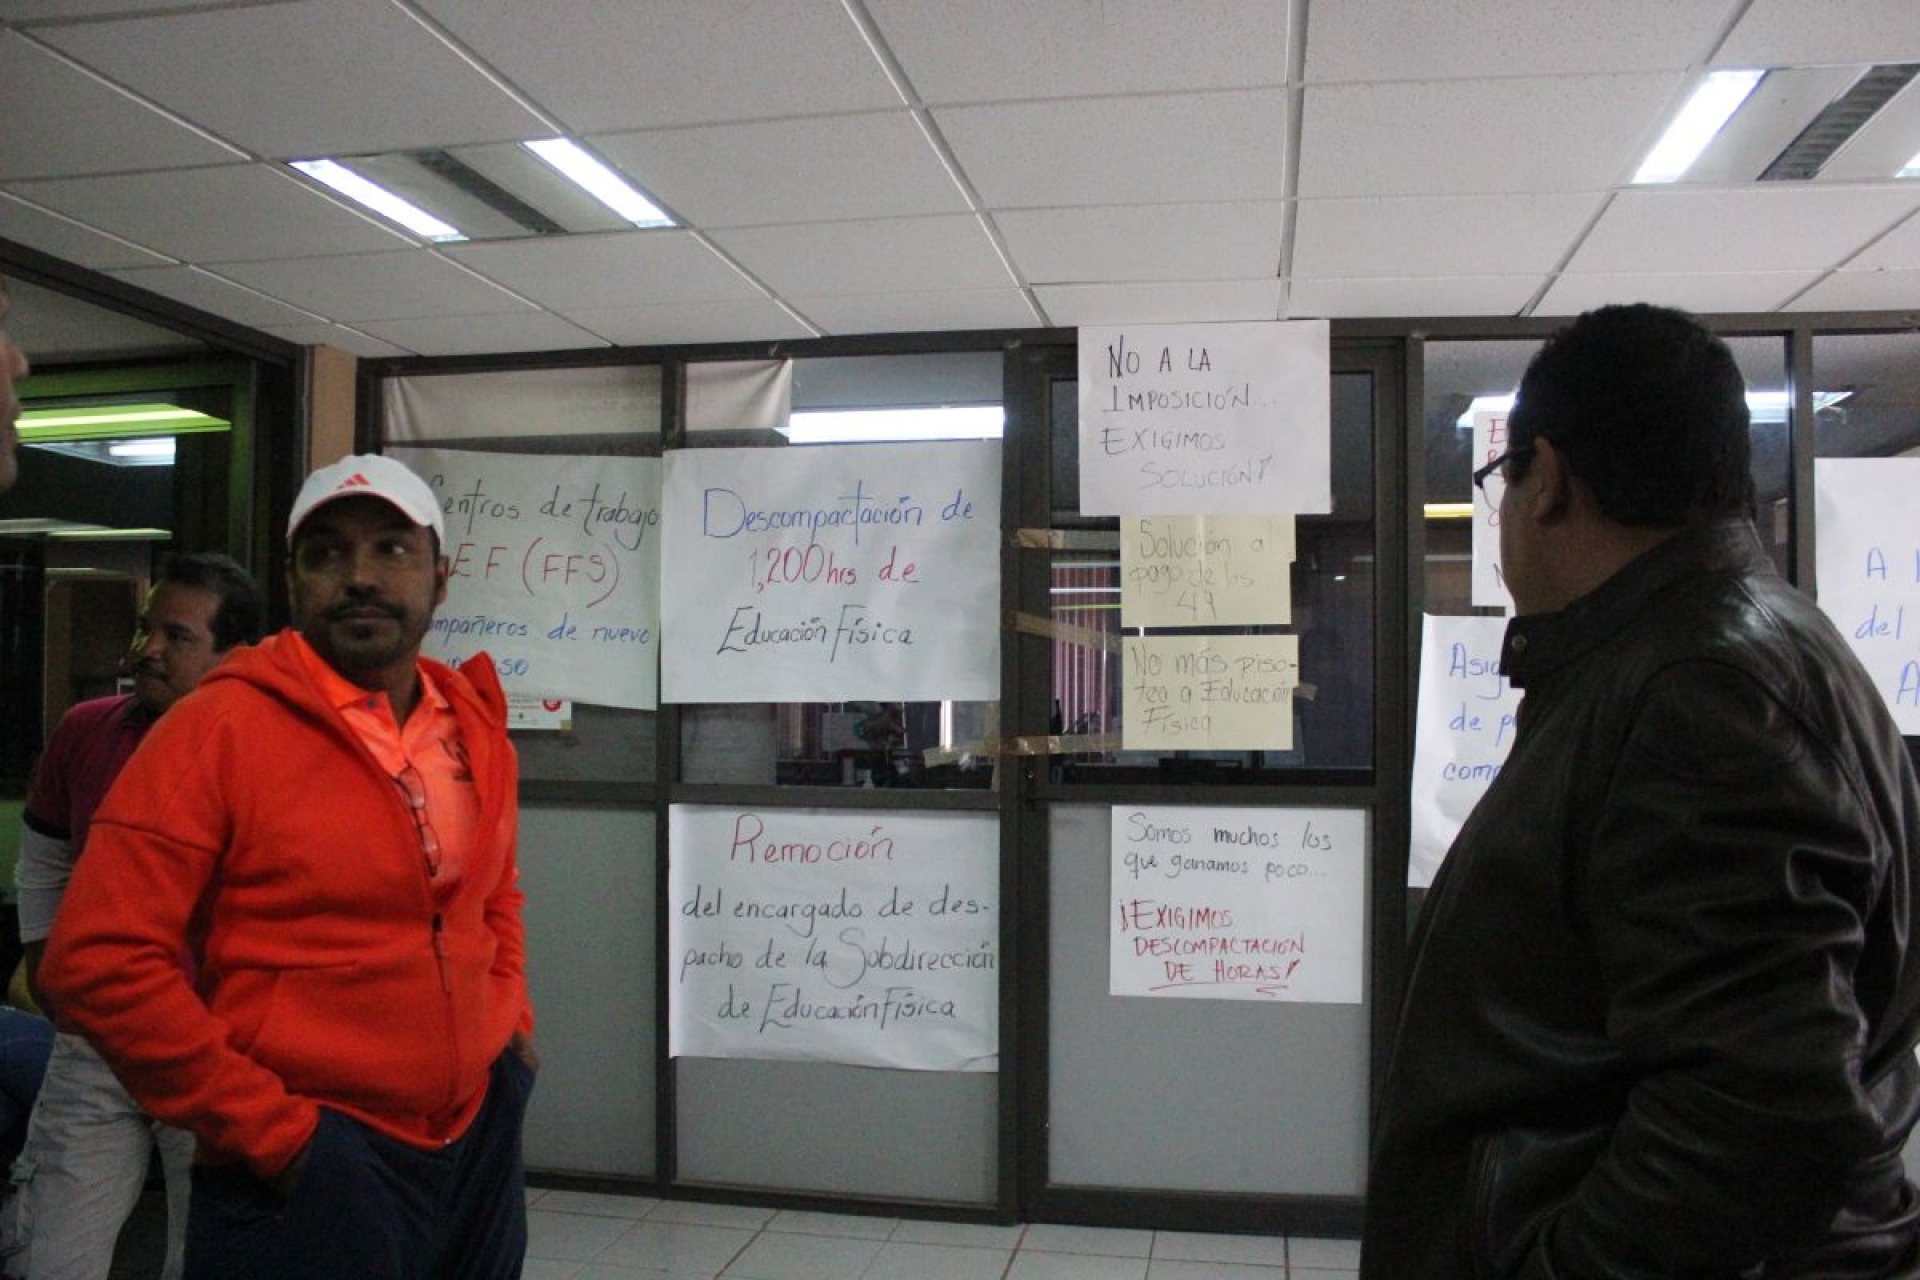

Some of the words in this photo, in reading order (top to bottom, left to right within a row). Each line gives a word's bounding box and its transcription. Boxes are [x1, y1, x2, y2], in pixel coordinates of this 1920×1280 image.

[1109, 334, 1140, 378] NO
[1160, 346, 1172, 372] A
[1189, 347, 1211, 372] LA
[1101, 427, 1226, 455] EXIGIMOS
[541, 485, 572, 517] de
[580, 482, 660, 551] trabajo
[704, 479, 923, 546] Descompactación
[942, 488, 974, 519] de
[523, 537, 620, 609] (FFS)
[878, 545, 920, 583] de
[1189, 560, 1217, 588] de
[1866, 546, 1888, 581] A
[547, 612, 578, 641] de
[592, 626, 650, 645] nuevo
[1855, 604, 1903, 640] del
[1132, 643, 1162, 676] No
[1176, 648, 1228, 678] más
[1180, 686, 1192, 704] a
[1449, 702, 1482, 731] de
[731, 813, 894, 863] Remoción
[1127, 812, 1192, 844] Somos
[1213, 824, 1280, 847] muchos
[1302, 820, 1332, 850] los
[1124, 852, 1159, 880] que
[1165, 854, 1249, 879] ganamos
[682, 884, 722, 918] del
[734, 887, 863, 938] encargado
[878, 885, 914, 917] de
[929, 883, 989, 915] des-
[680, 941, 744, 984] pacho
[755, 938, 787, 969] de
[806, 938, 828, 969] la
[1165, 961, 1194, 982] DE
[718, 983, 750, 1018] de
